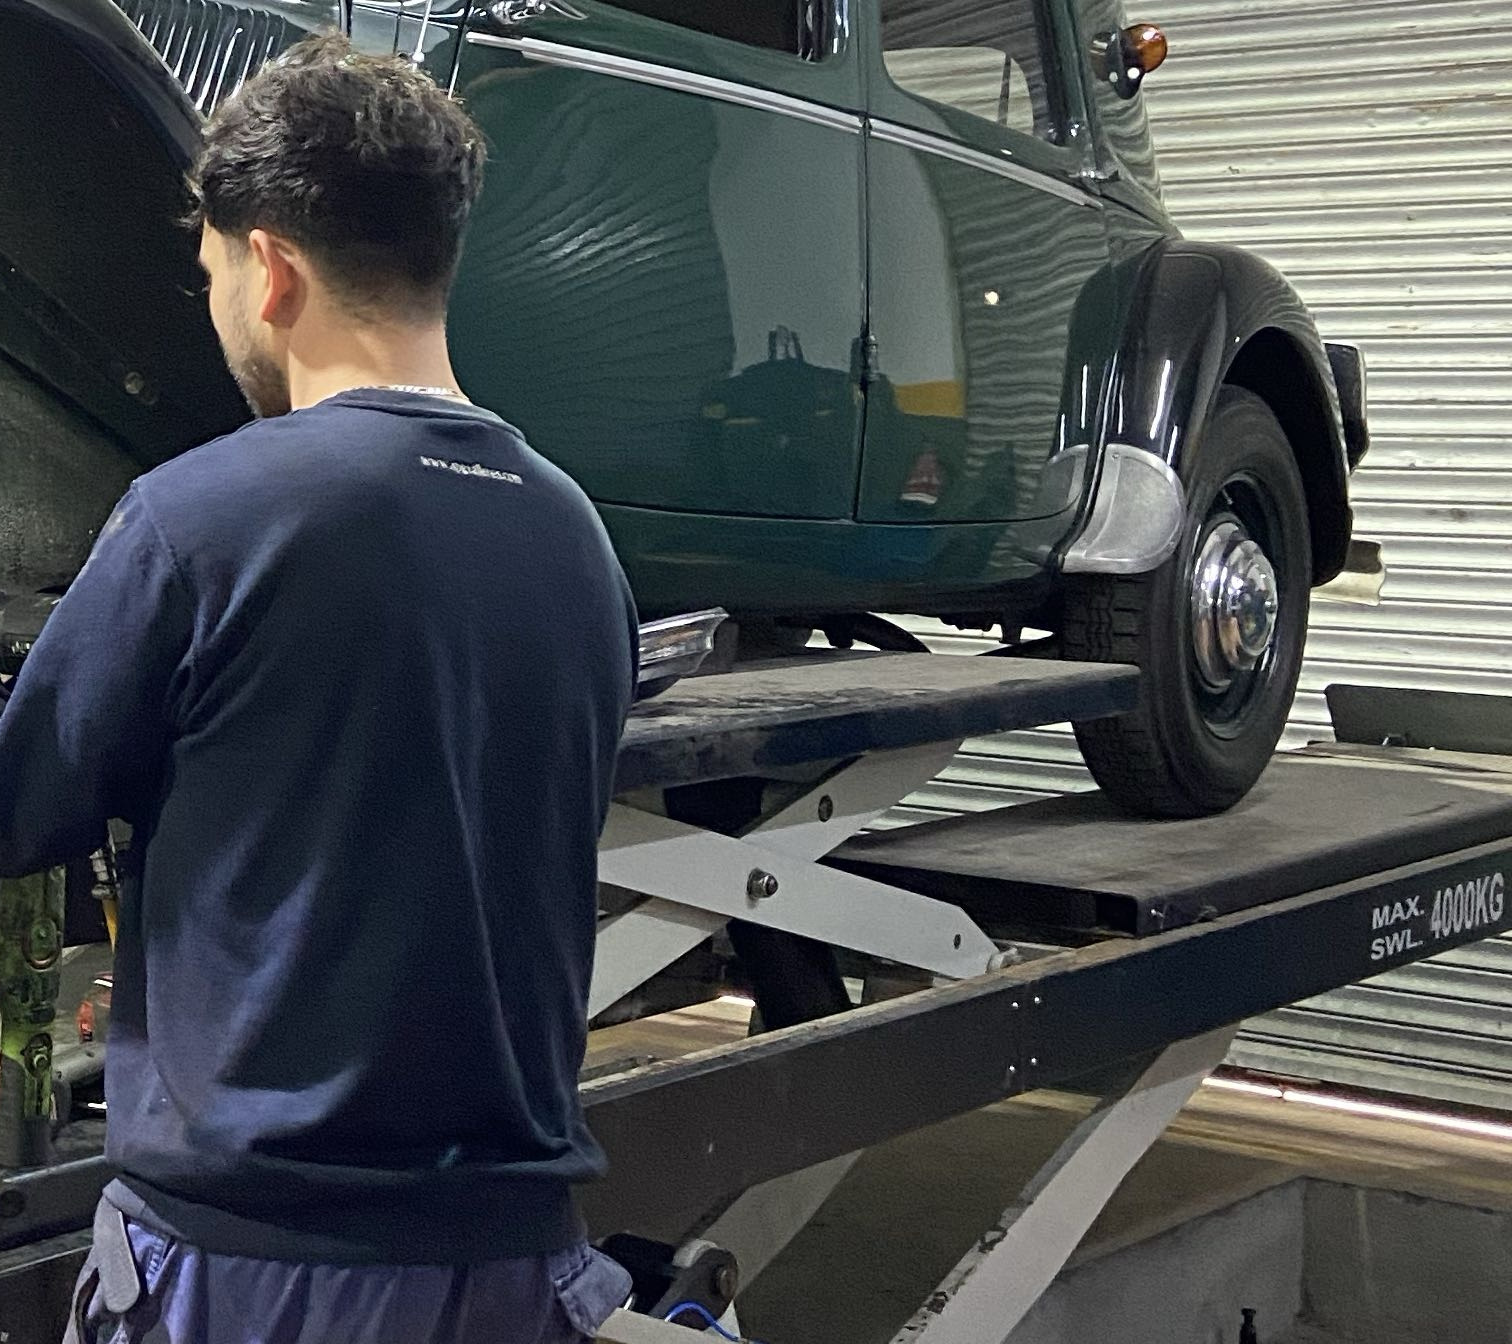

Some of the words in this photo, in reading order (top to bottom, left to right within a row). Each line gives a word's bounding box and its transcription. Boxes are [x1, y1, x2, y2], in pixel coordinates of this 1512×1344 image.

[1372, 895, 1425, 929] MAX.
[1430, 872, 1504, 939] 4000KG
[1371, 929, 1424, 960] SWL.
